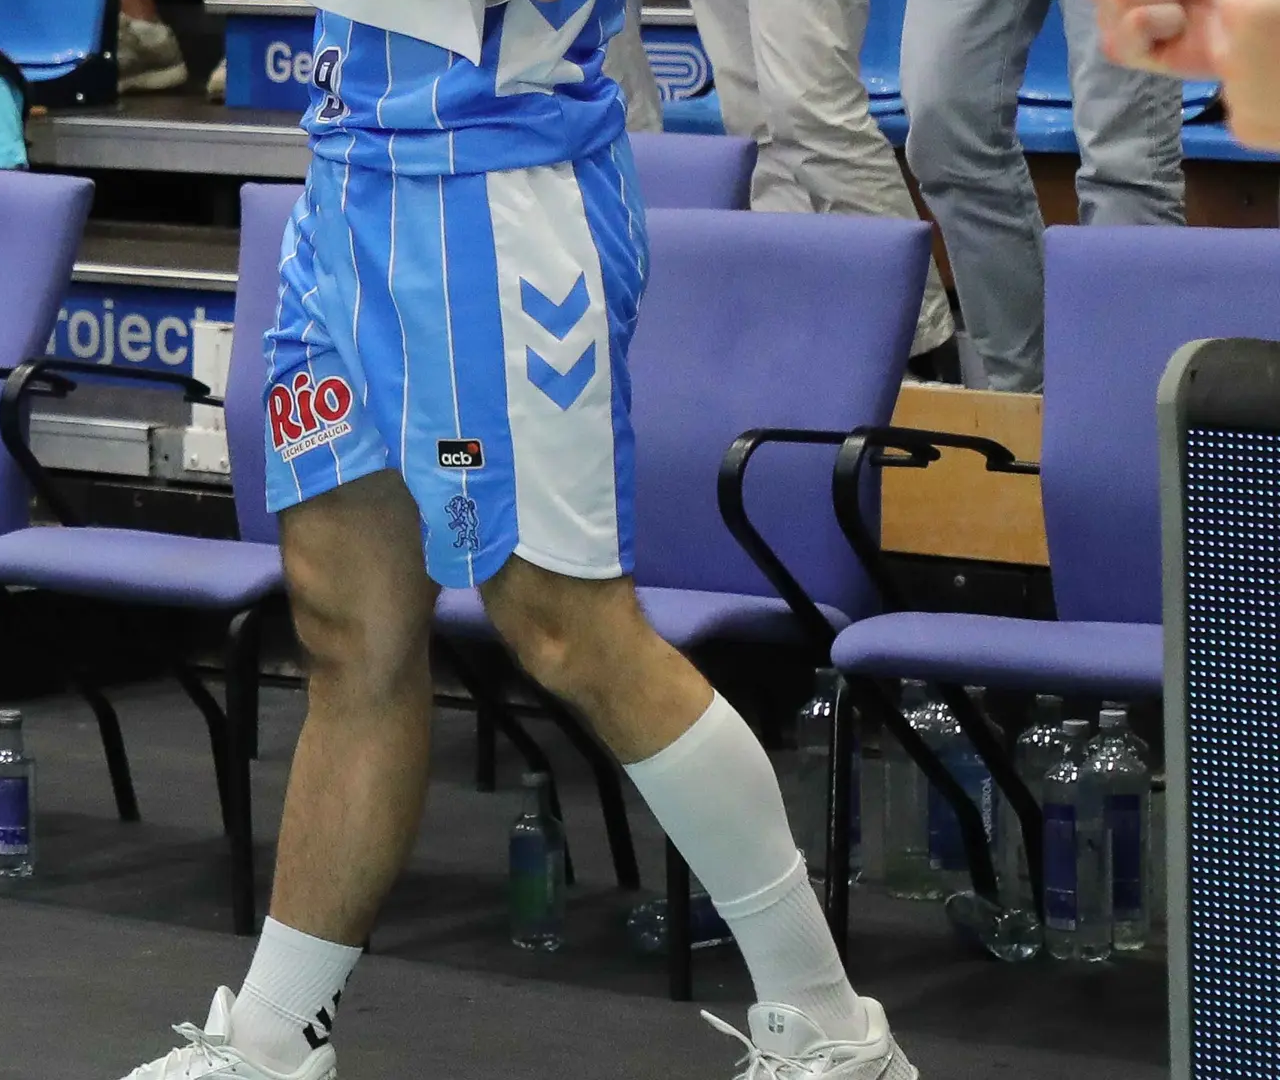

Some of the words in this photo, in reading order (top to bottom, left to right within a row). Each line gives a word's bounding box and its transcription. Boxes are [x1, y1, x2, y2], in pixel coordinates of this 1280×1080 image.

[282, 443, 304, 460] LECHE
[305, 437, 317, 448] DE
[317, 423, 350, 443] GALICIA
[442, 451, 473, 466] acb
